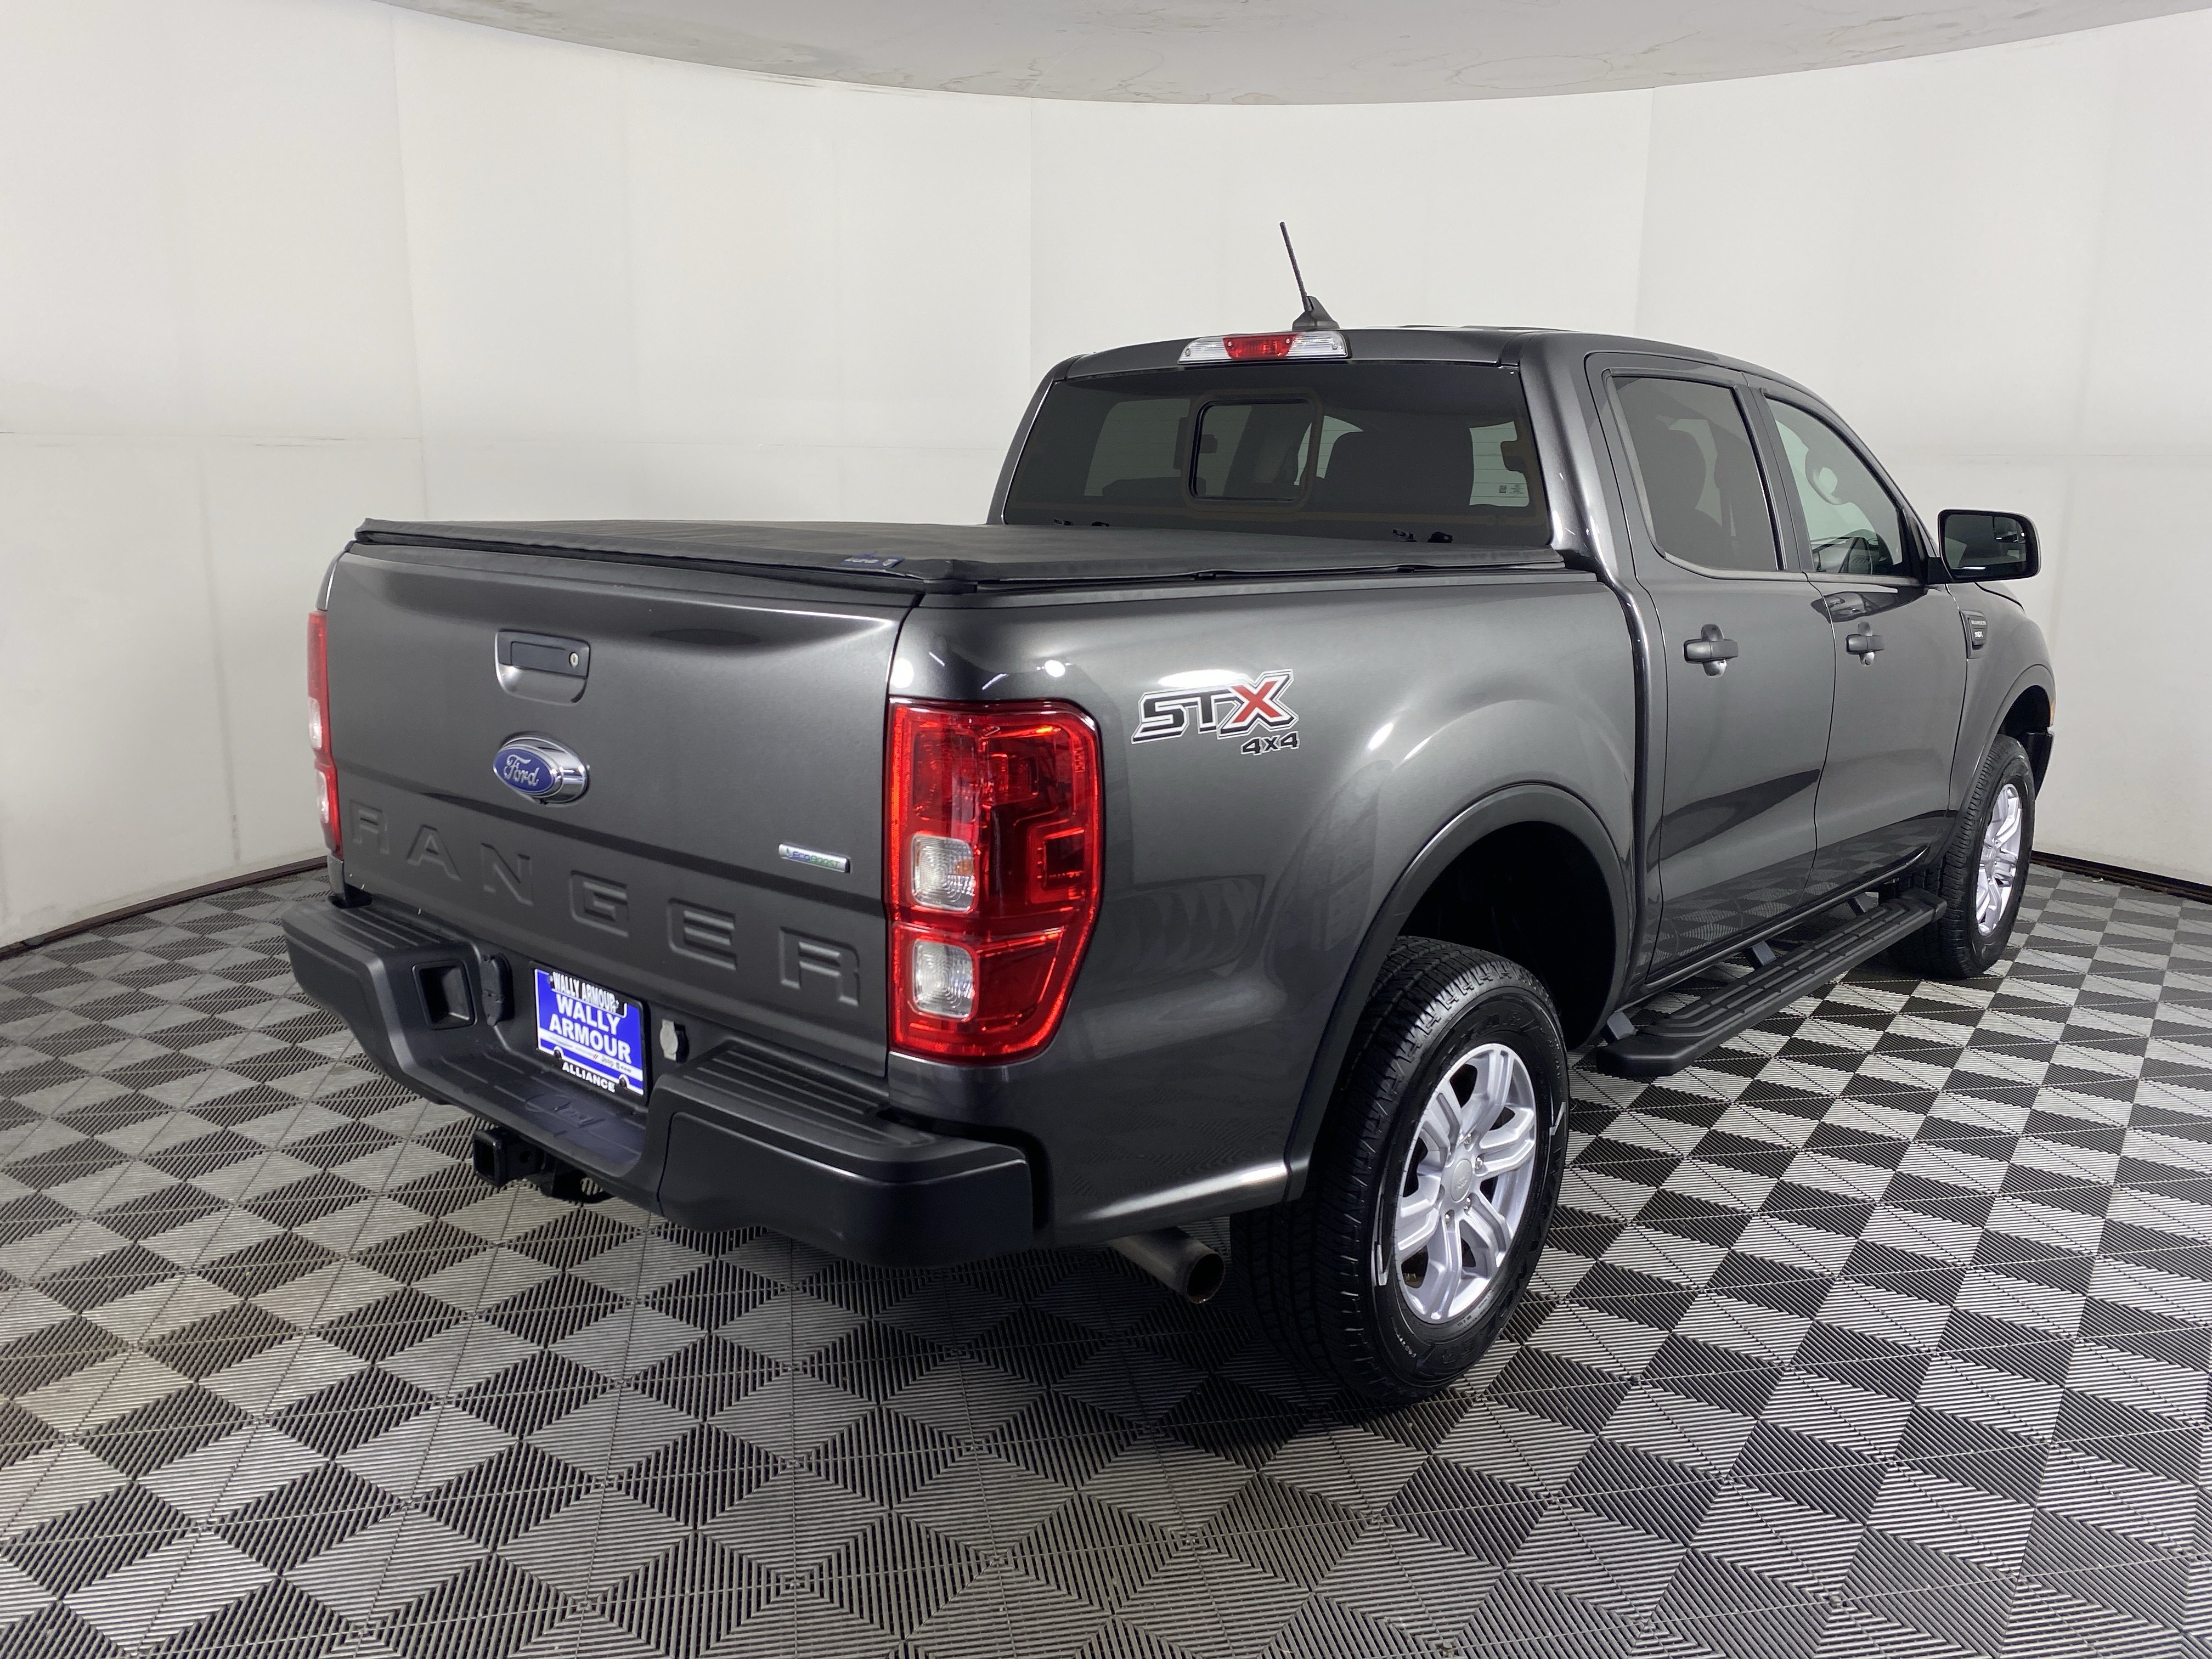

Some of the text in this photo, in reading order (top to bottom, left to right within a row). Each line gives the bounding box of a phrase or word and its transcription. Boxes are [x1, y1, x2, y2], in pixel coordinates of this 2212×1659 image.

[1131, 669, 1299, 744] STX
[503, 754, 540, 787] Ford
[349, 799, 860, 1007] RANGER
[552, 971, 617, 1013] WALLY ARMOUR
[556, 993, 621, 1036] WALLY
[549, 1013, 632, 1064] ARMOUR
[562, 1062, 616, 1093] ALLIANCE
